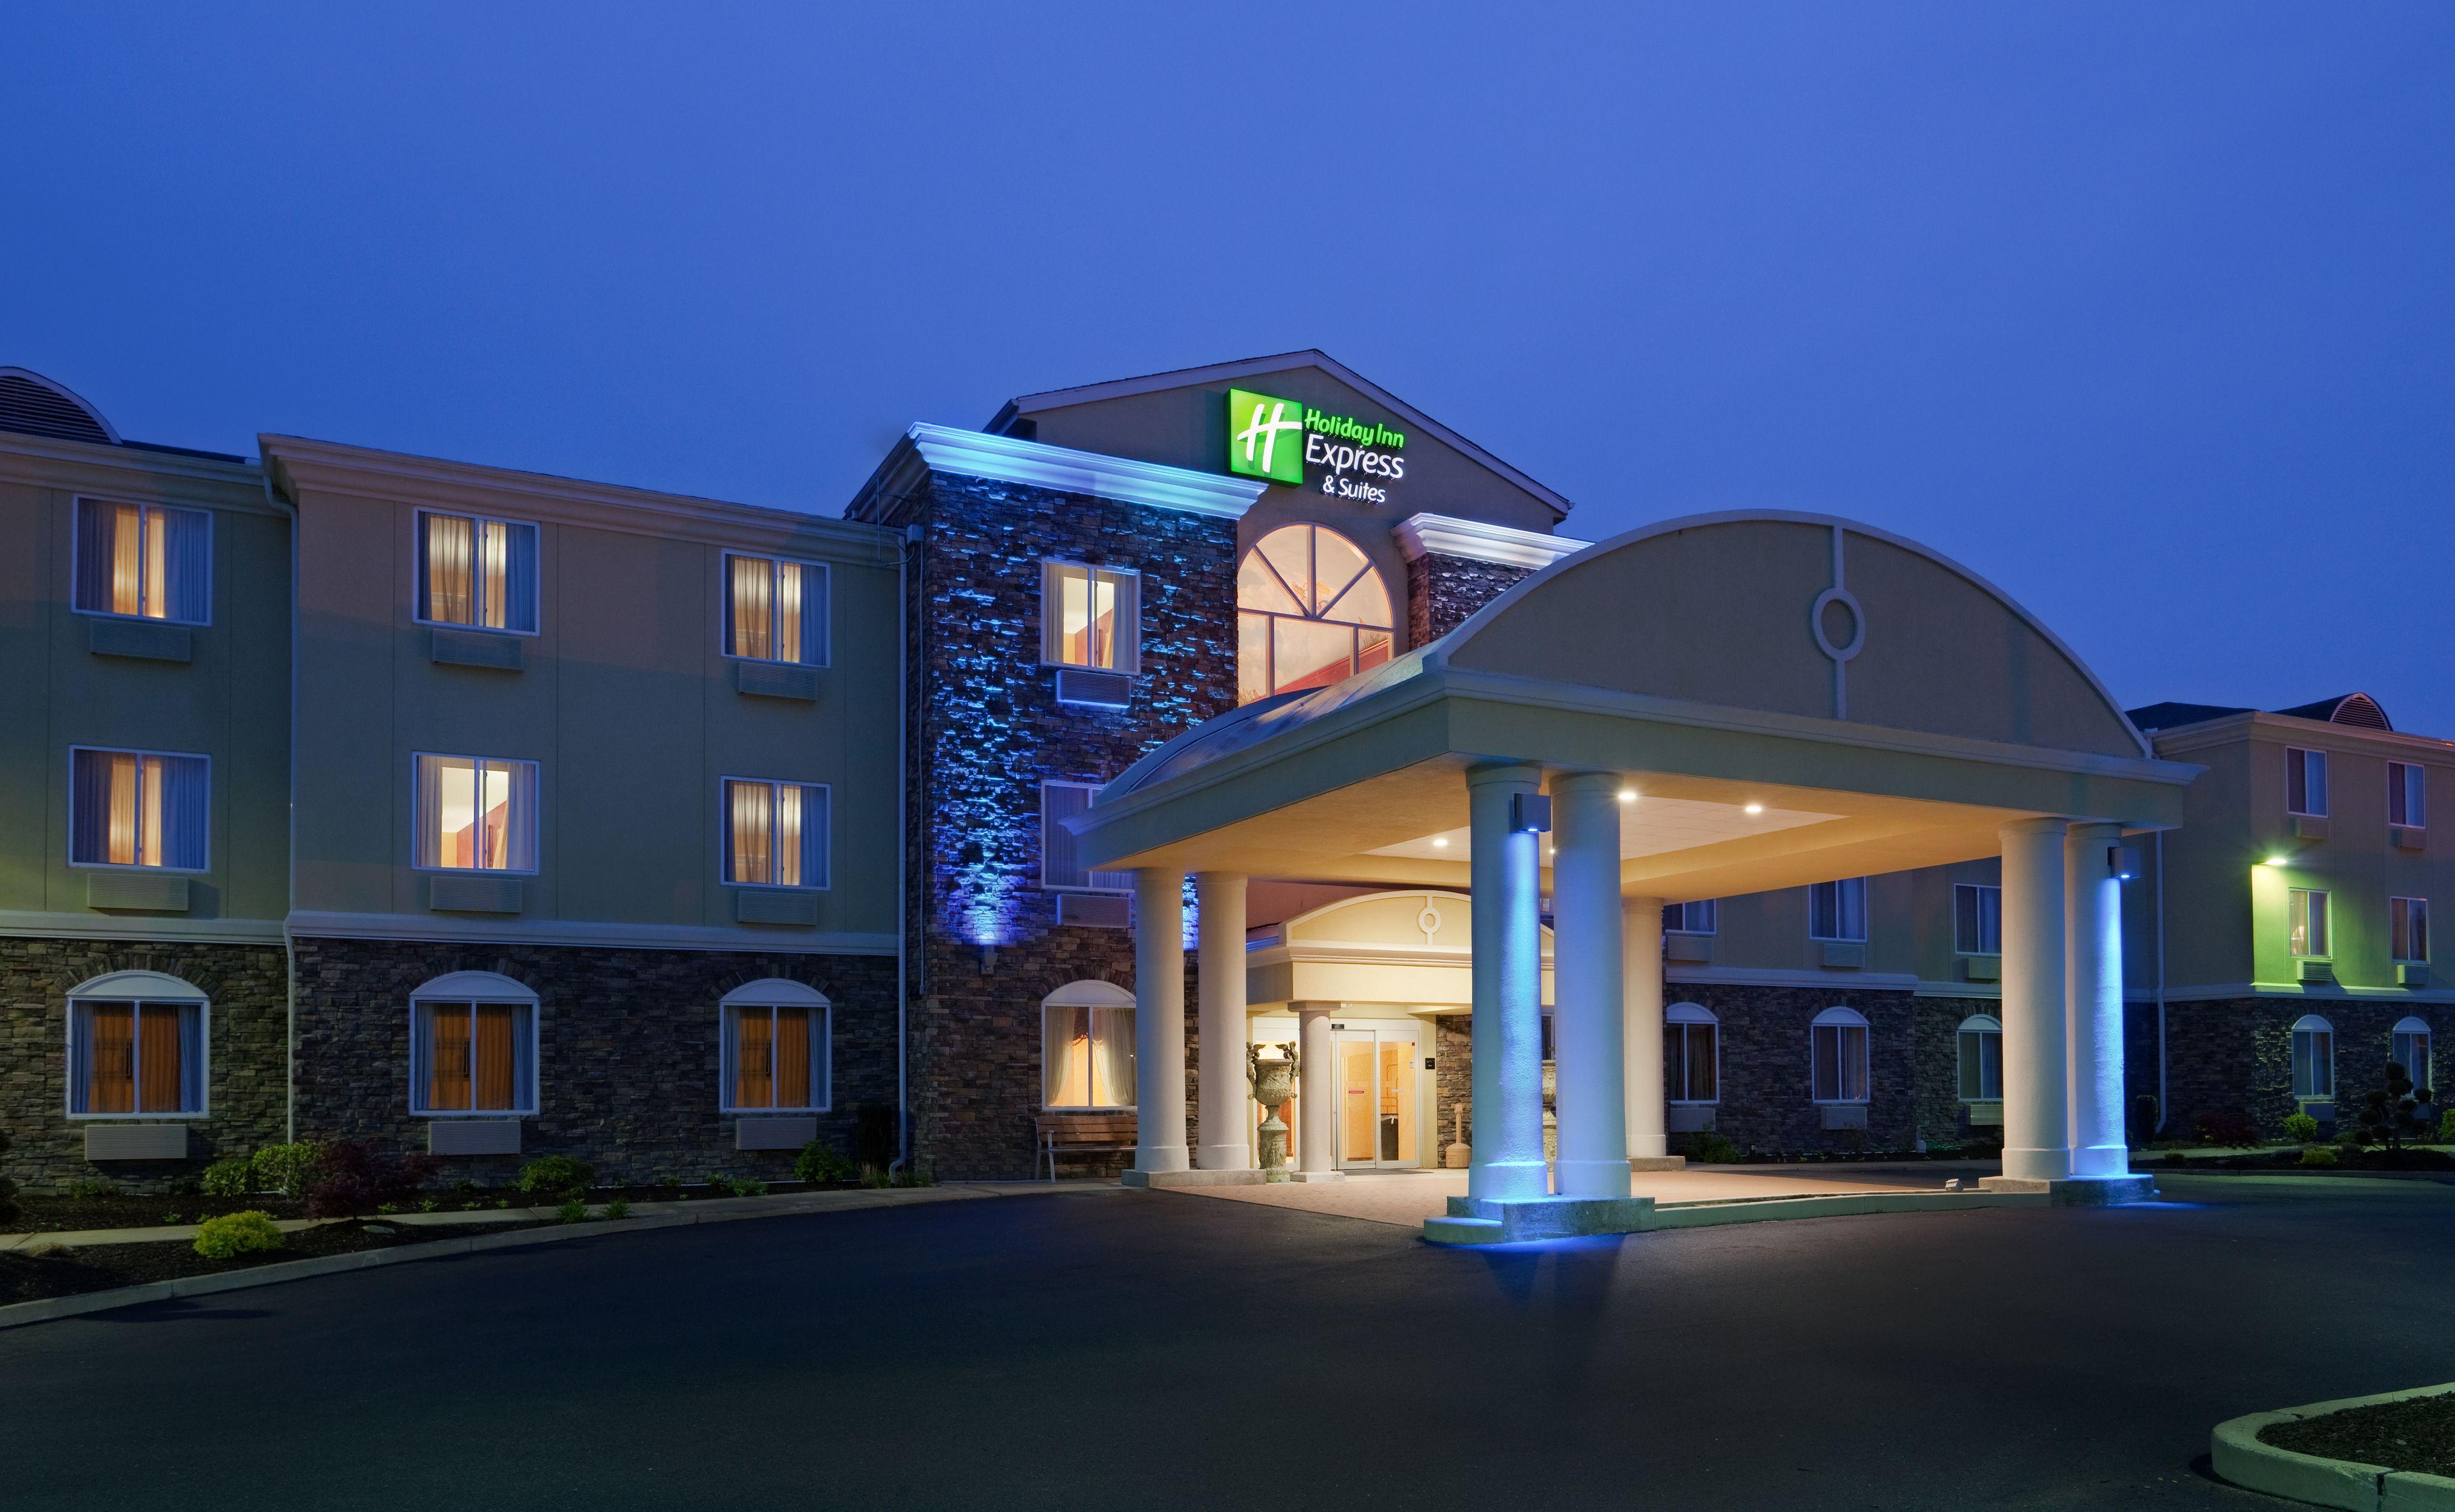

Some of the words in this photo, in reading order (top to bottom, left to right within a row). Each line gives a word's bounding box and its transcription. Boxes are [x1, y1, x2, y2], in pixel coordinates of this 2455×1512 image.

[1237, 403, 1302, 472] H
[1305, 409, 1374, 446] Holiday
[1376, 423, 1404, 448] Inn
[1305, 433, 1405, 479] Express
[1323, 475, 1335, 494] &
[1338, 478, 1385, 503] Suites
